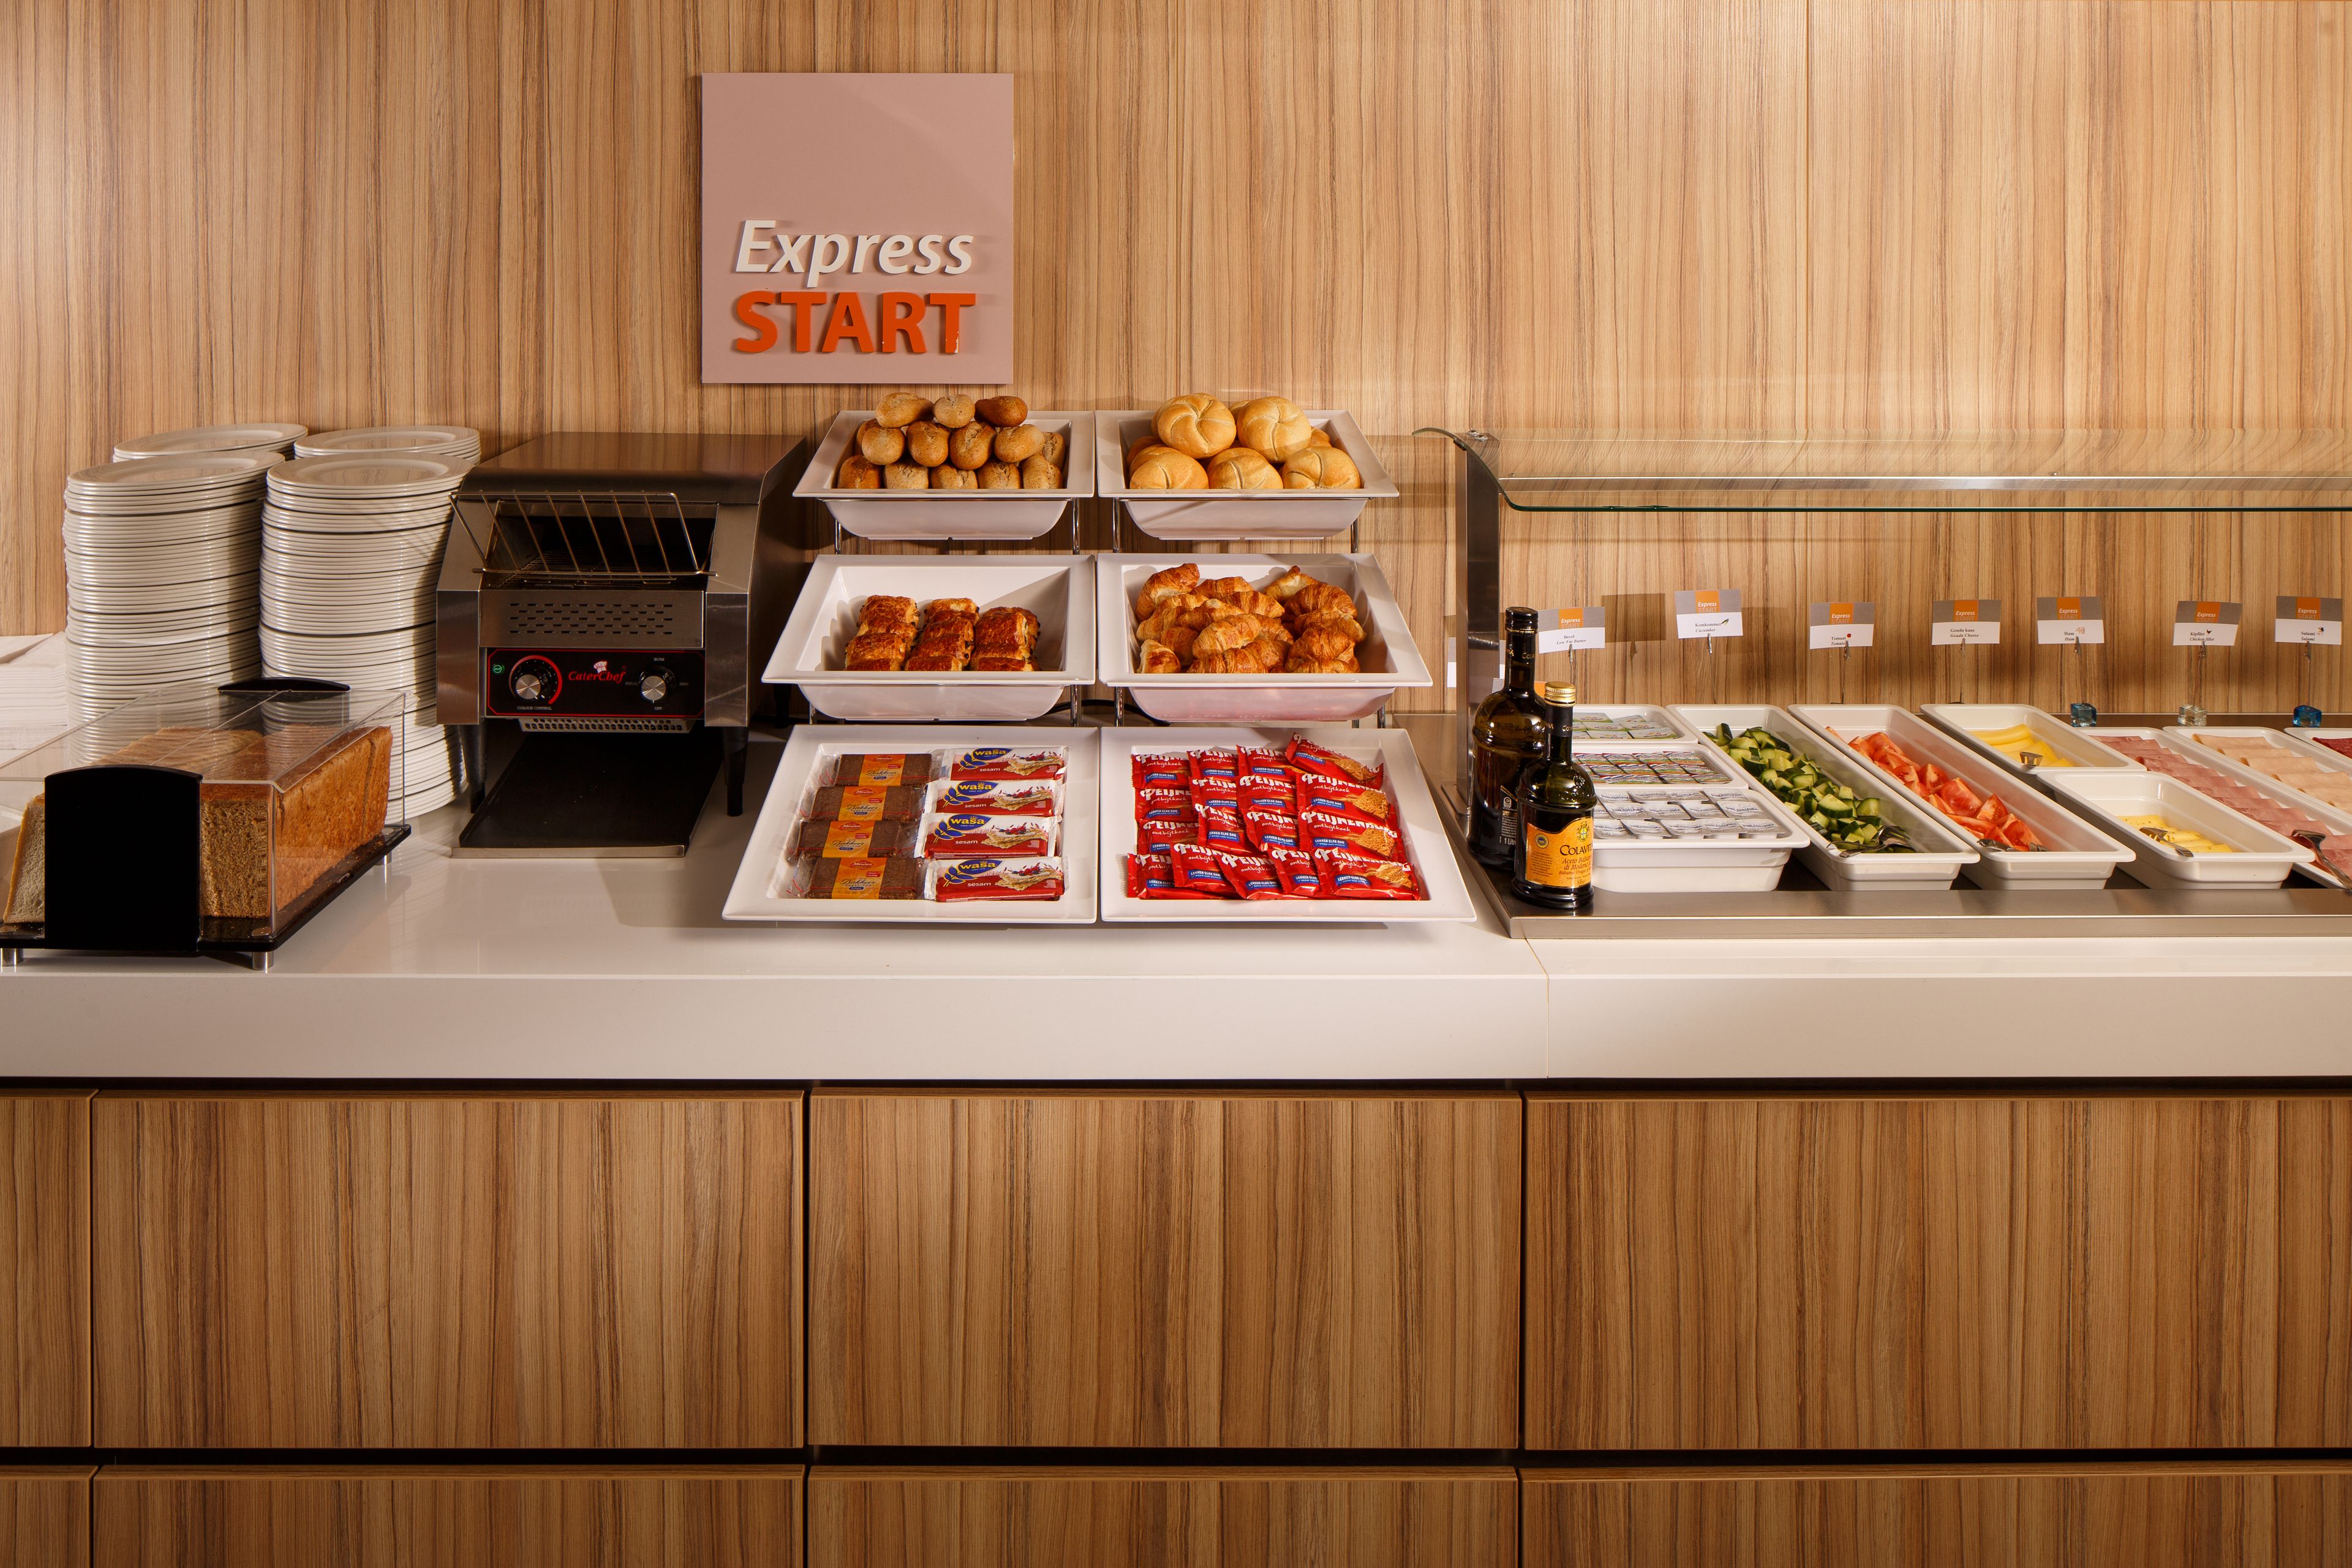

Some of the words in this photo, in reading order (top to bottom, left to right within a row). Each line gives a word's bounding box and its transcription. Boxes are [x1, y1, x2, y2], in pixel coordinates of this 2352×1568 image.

[736, 220, 973, 288] Express
[736, 290, 976, 354] START
[568, 671, 625, 685] CaterChef
[1313, 785, 1350, 793] ontbijtkoek
[1152, 829, 1190, 837] ontbijtkoek
